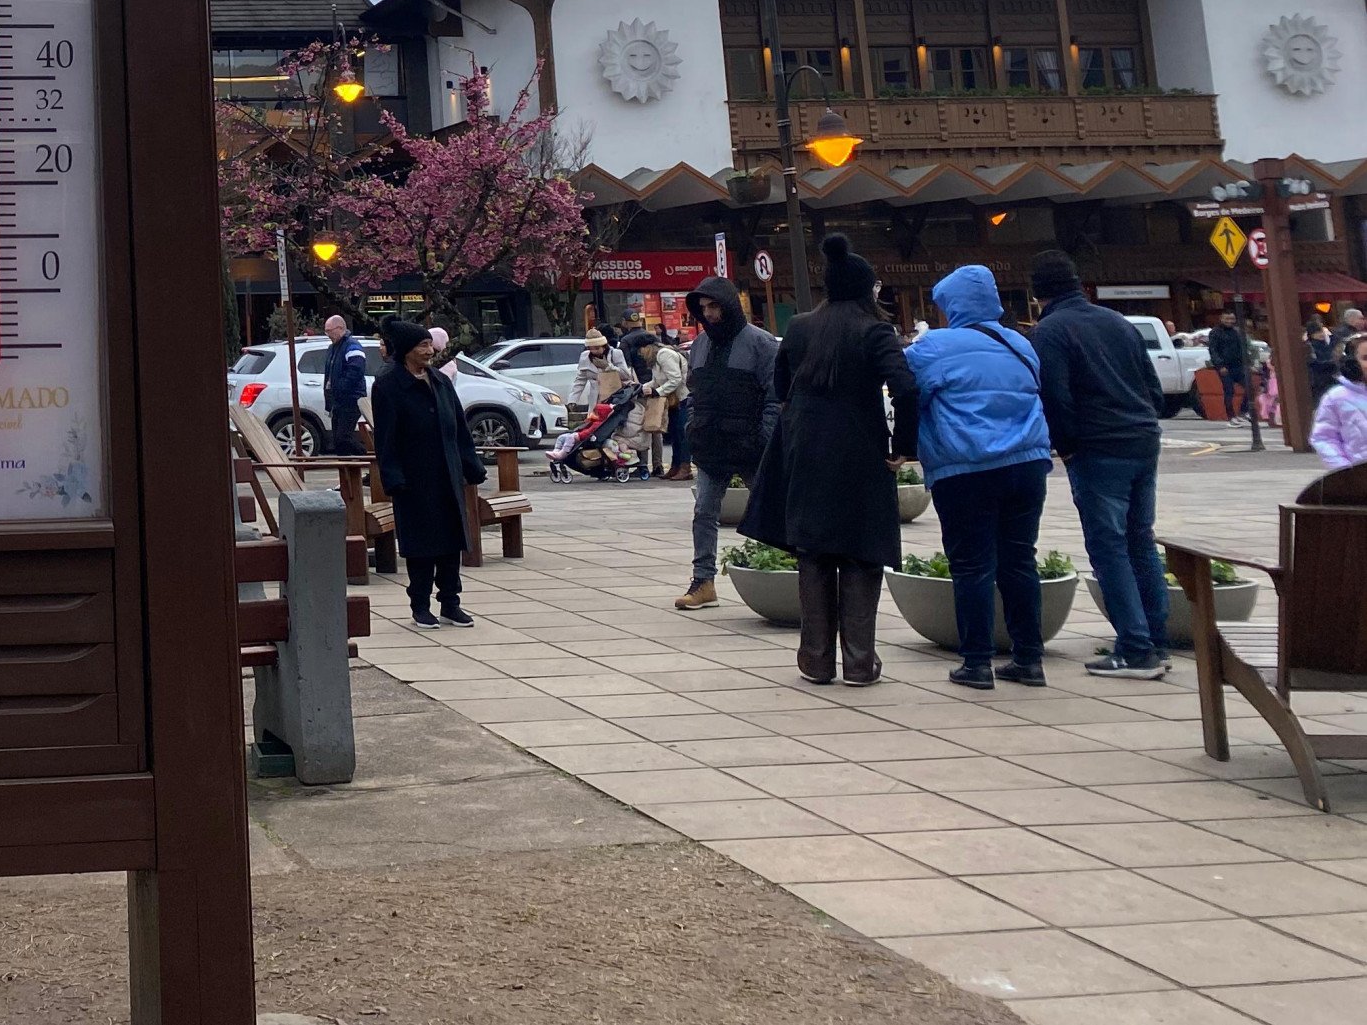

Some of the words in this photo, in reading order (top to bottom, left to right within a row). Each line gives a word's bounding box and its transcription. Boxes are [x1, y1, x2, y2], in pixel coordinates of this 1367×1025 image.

[36, 40, 74, 68] 40
[35, 89, 64, 110] 32
[35, 144, 72, 173] 20
[1194, 209, 1220, 218] Borges
[42, 250, 60, 280] 0
